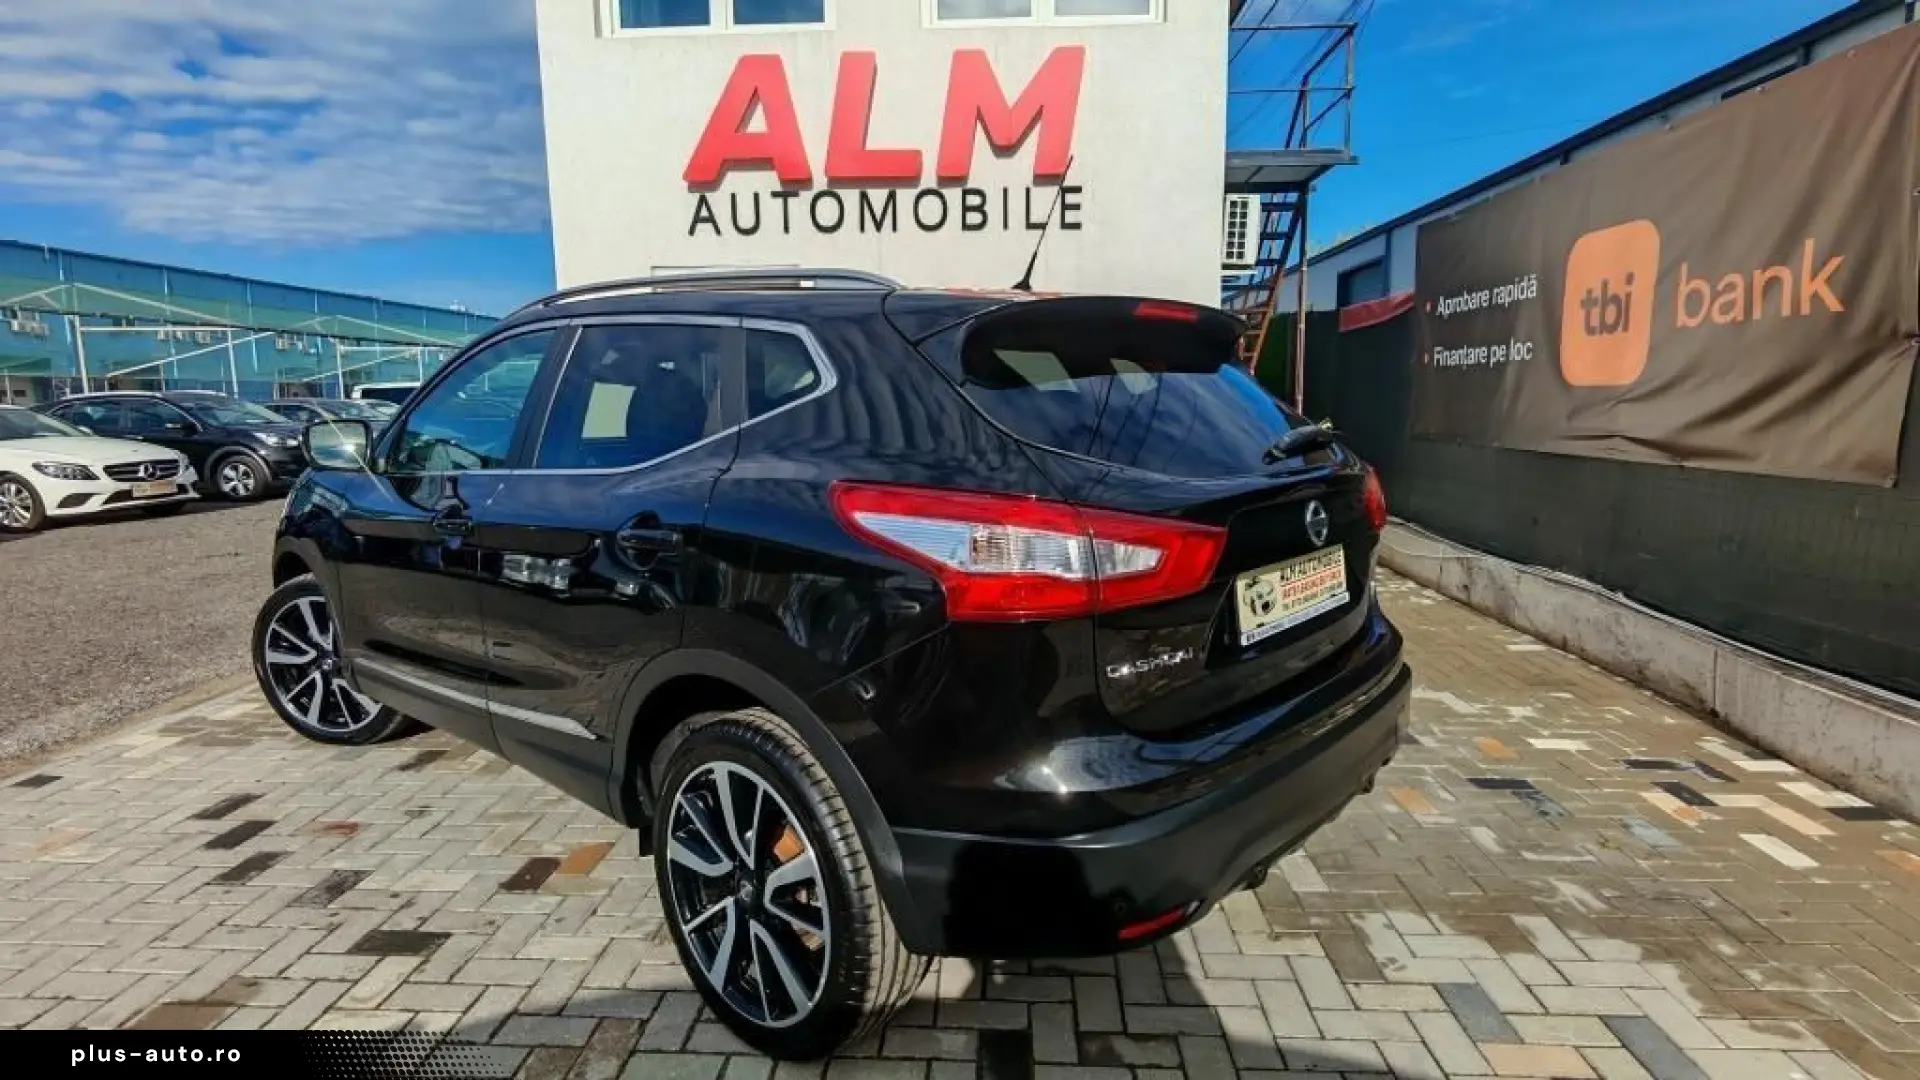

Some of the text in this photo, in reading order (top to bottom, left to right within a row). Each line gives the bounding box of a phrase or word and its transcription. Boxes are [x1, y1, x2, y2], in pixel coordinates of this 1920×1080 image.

[682, 46, 1087, 184] ALM
[687, 185, 1083, 236] AUTOMOBILE
[1436, 273, 1538, 319] Aprobare rapidă
[1580, 237, 1846, 337] tbi bank
[1489, 343, 1507, 369] pe
[1509, 336, 1533, 361] loc
